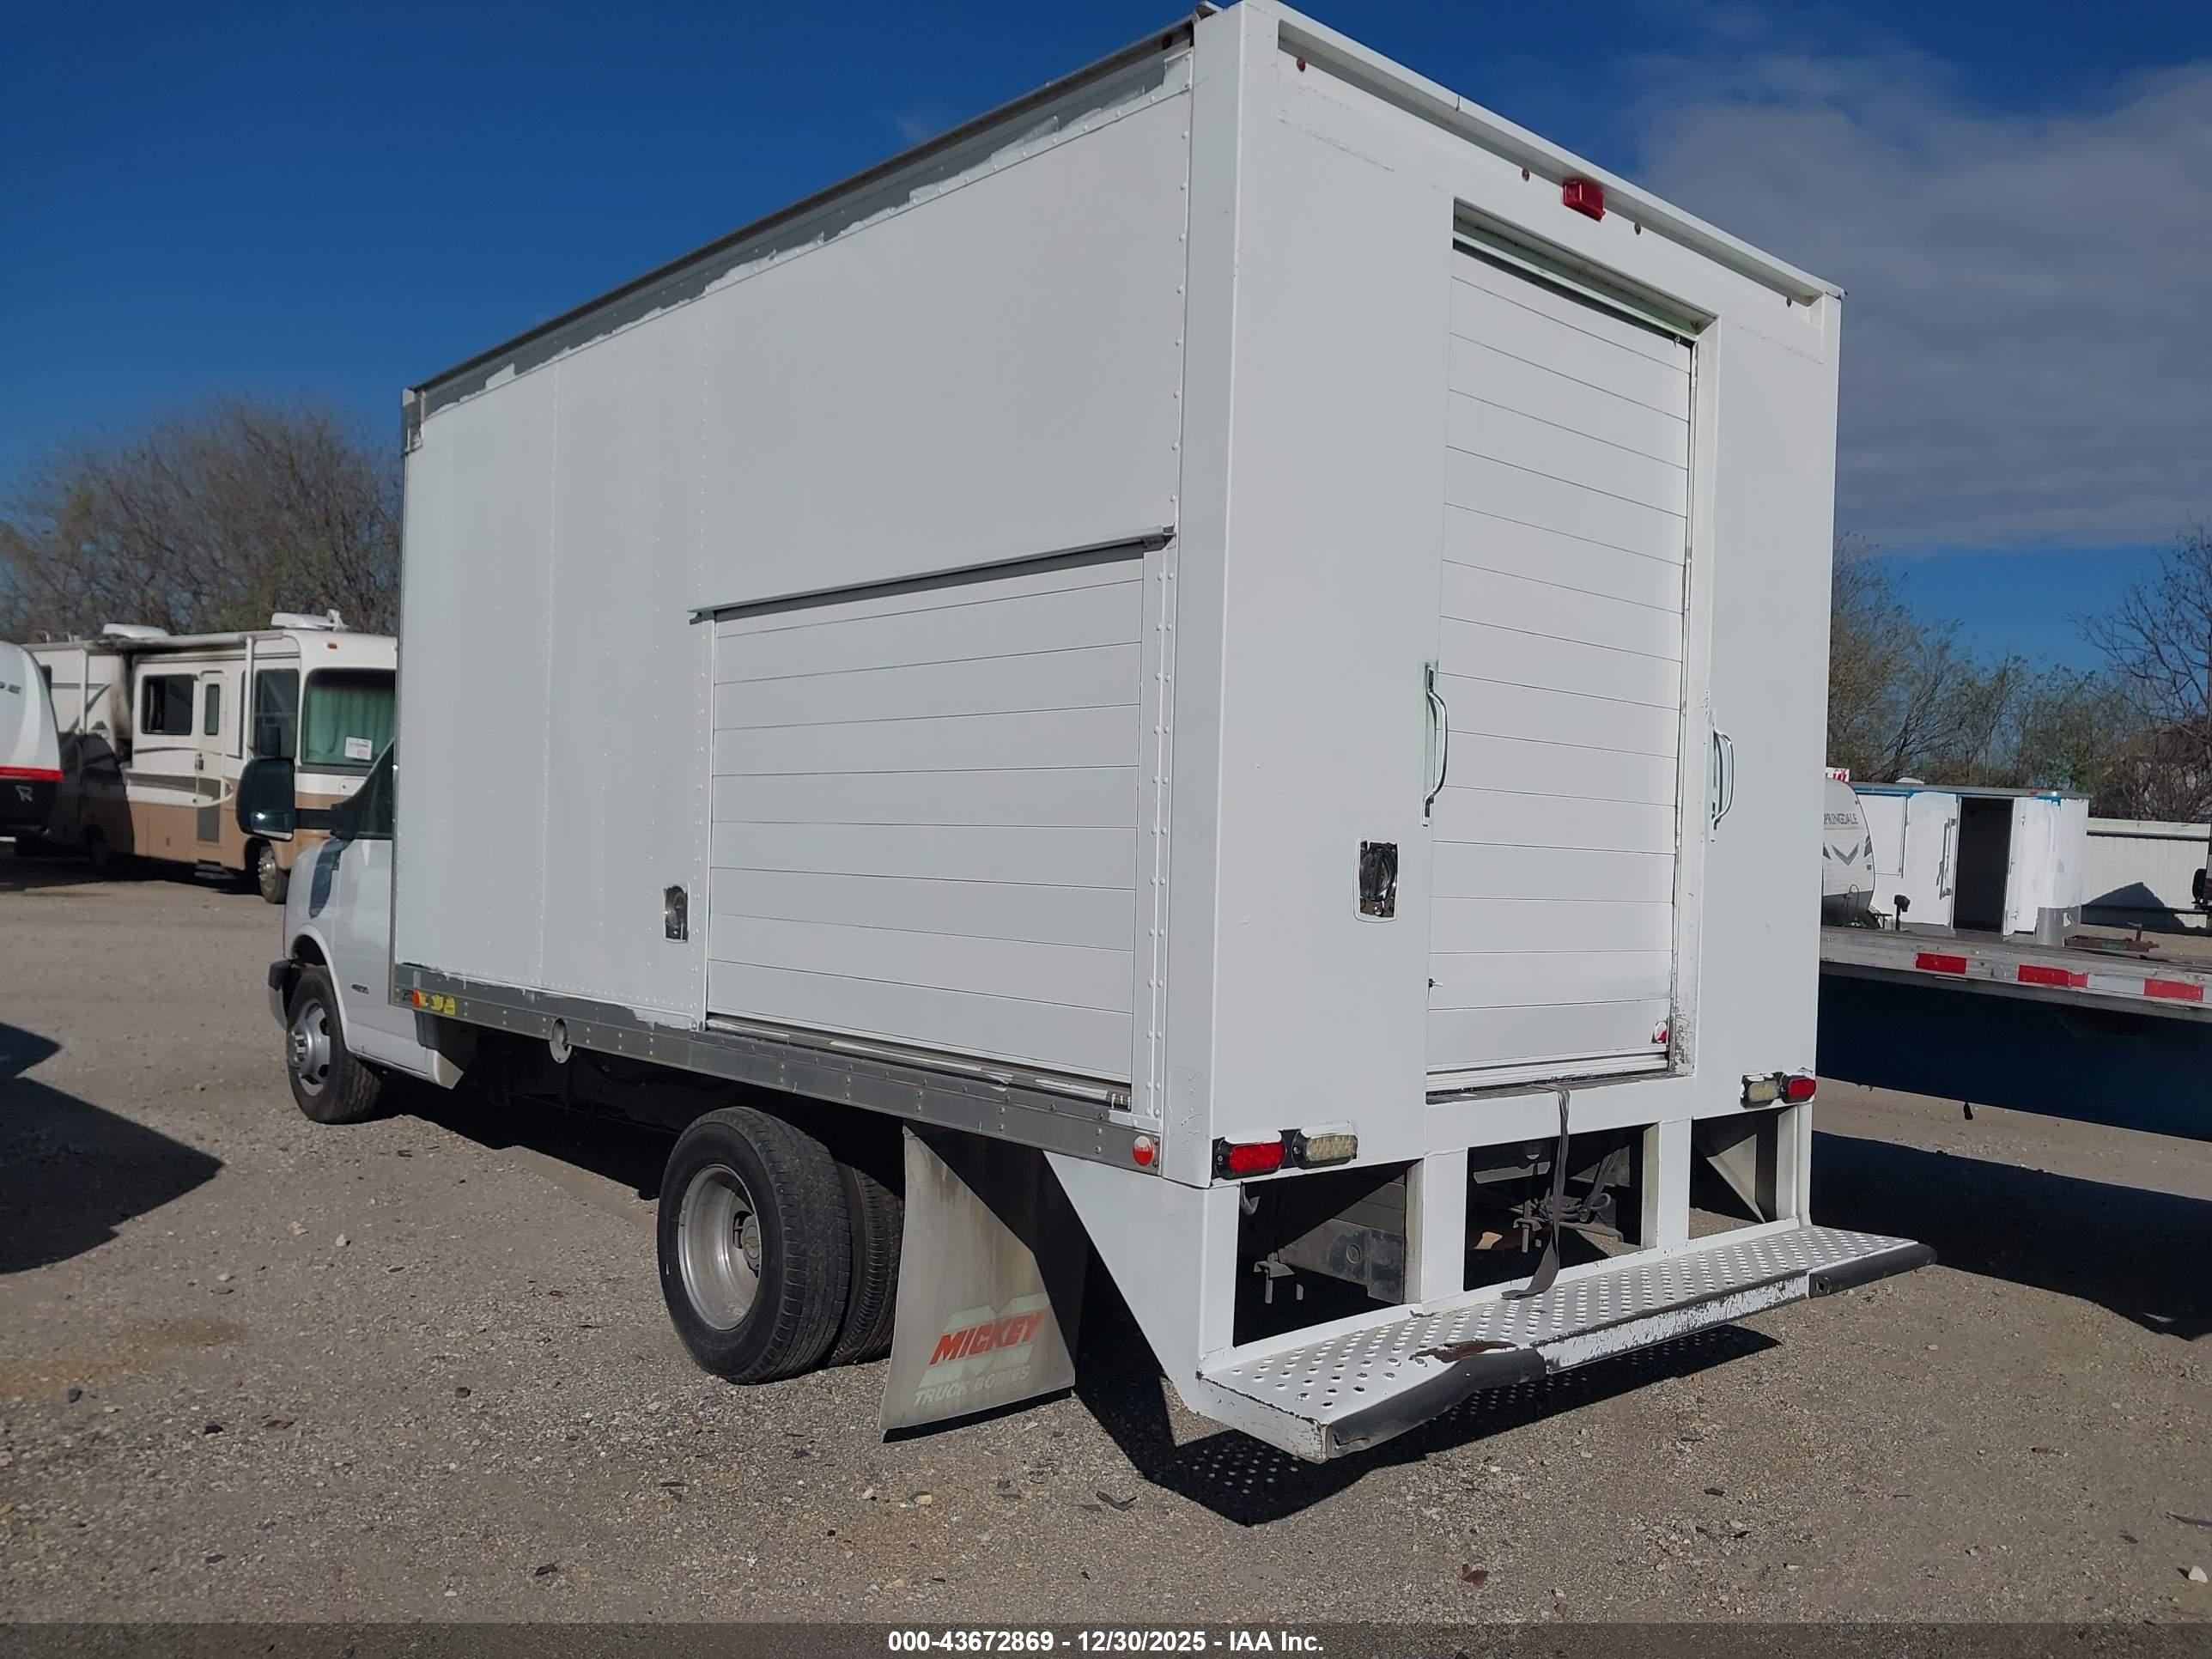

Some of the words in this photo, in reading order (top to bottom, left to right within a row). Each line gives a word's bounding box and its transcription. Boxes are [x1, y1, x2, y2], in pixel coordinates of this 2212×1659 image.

[1823, 812, 1859, 825] PRINGDALE
[929, 1312, 1042, 1365] MICKEY
[913, 1382, 969, 1407] TRUCK
